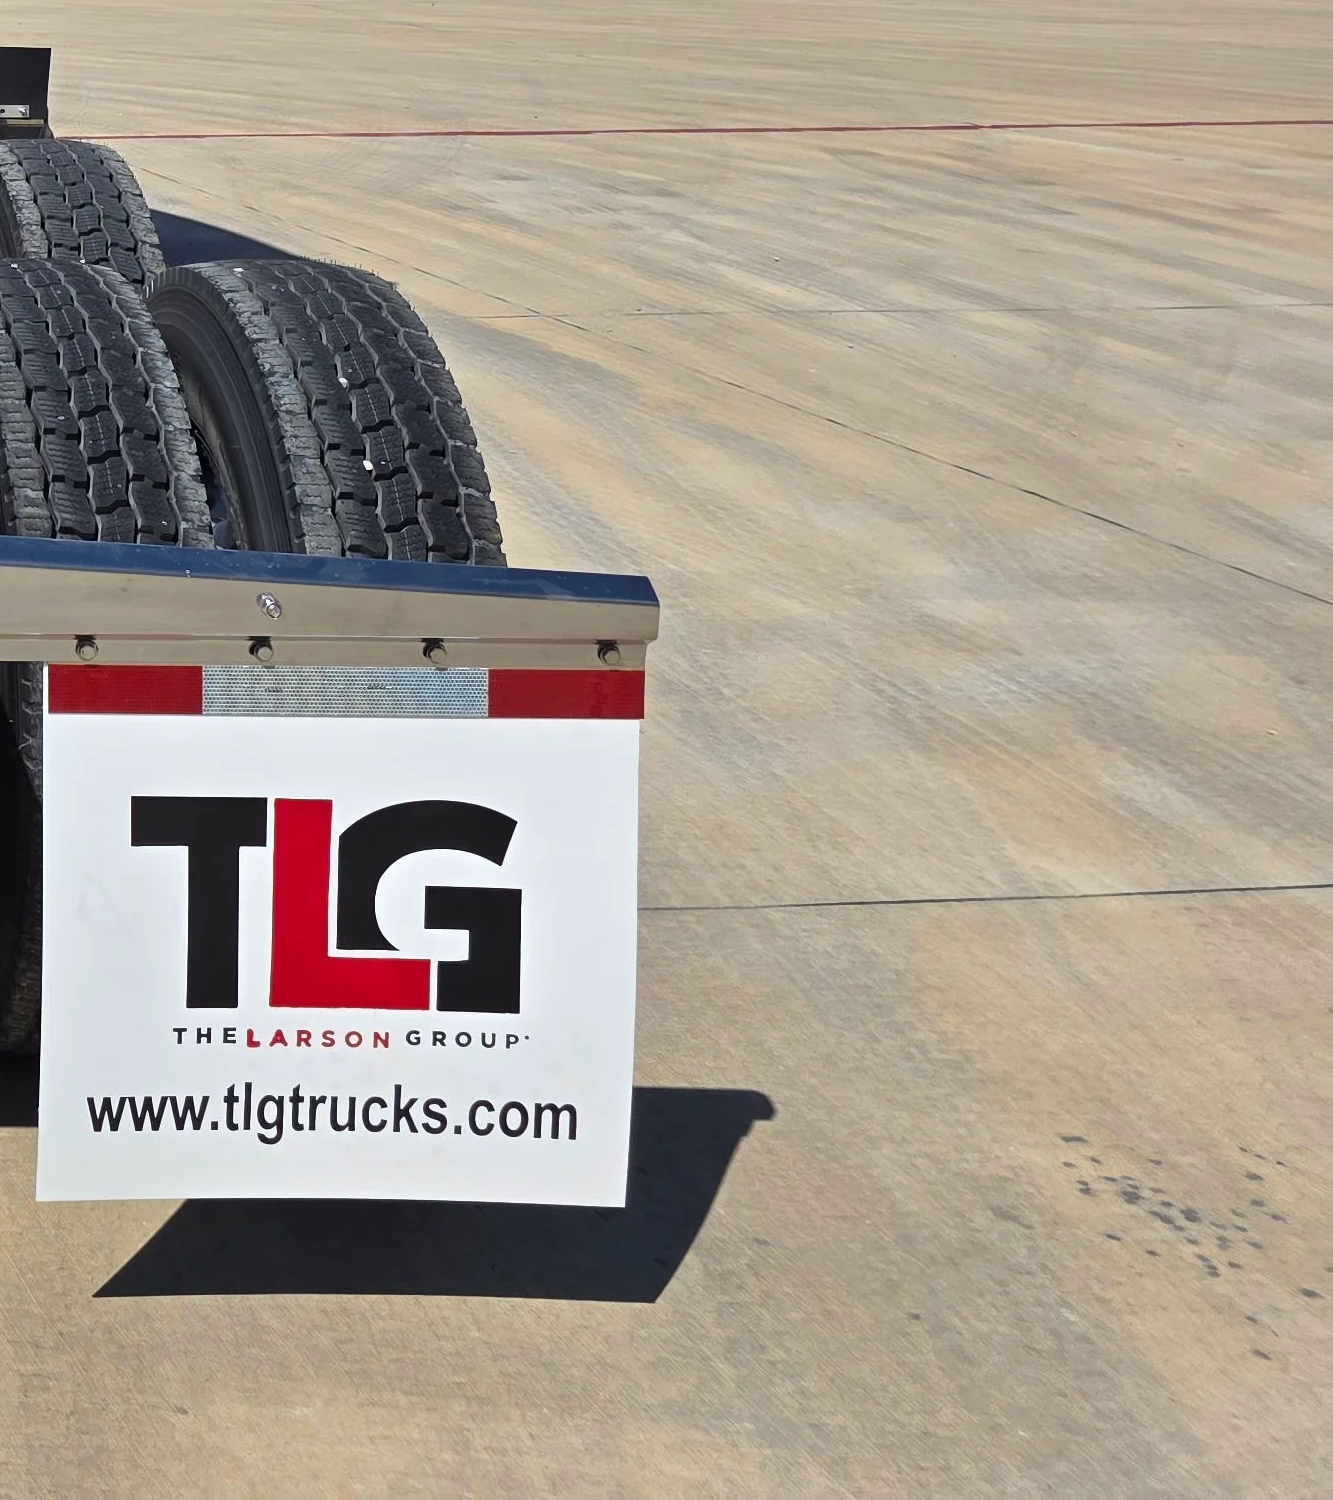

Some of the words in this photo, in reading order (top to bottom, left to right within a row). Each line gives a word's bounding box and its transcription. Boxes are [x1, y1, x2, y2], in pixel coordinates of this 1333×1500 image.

[130, 795, 523, 1015] TLG
[405, 1029, 520, 1050] GROUP
[86, 1081, 578, 1145] www.tlgtrucks.com
